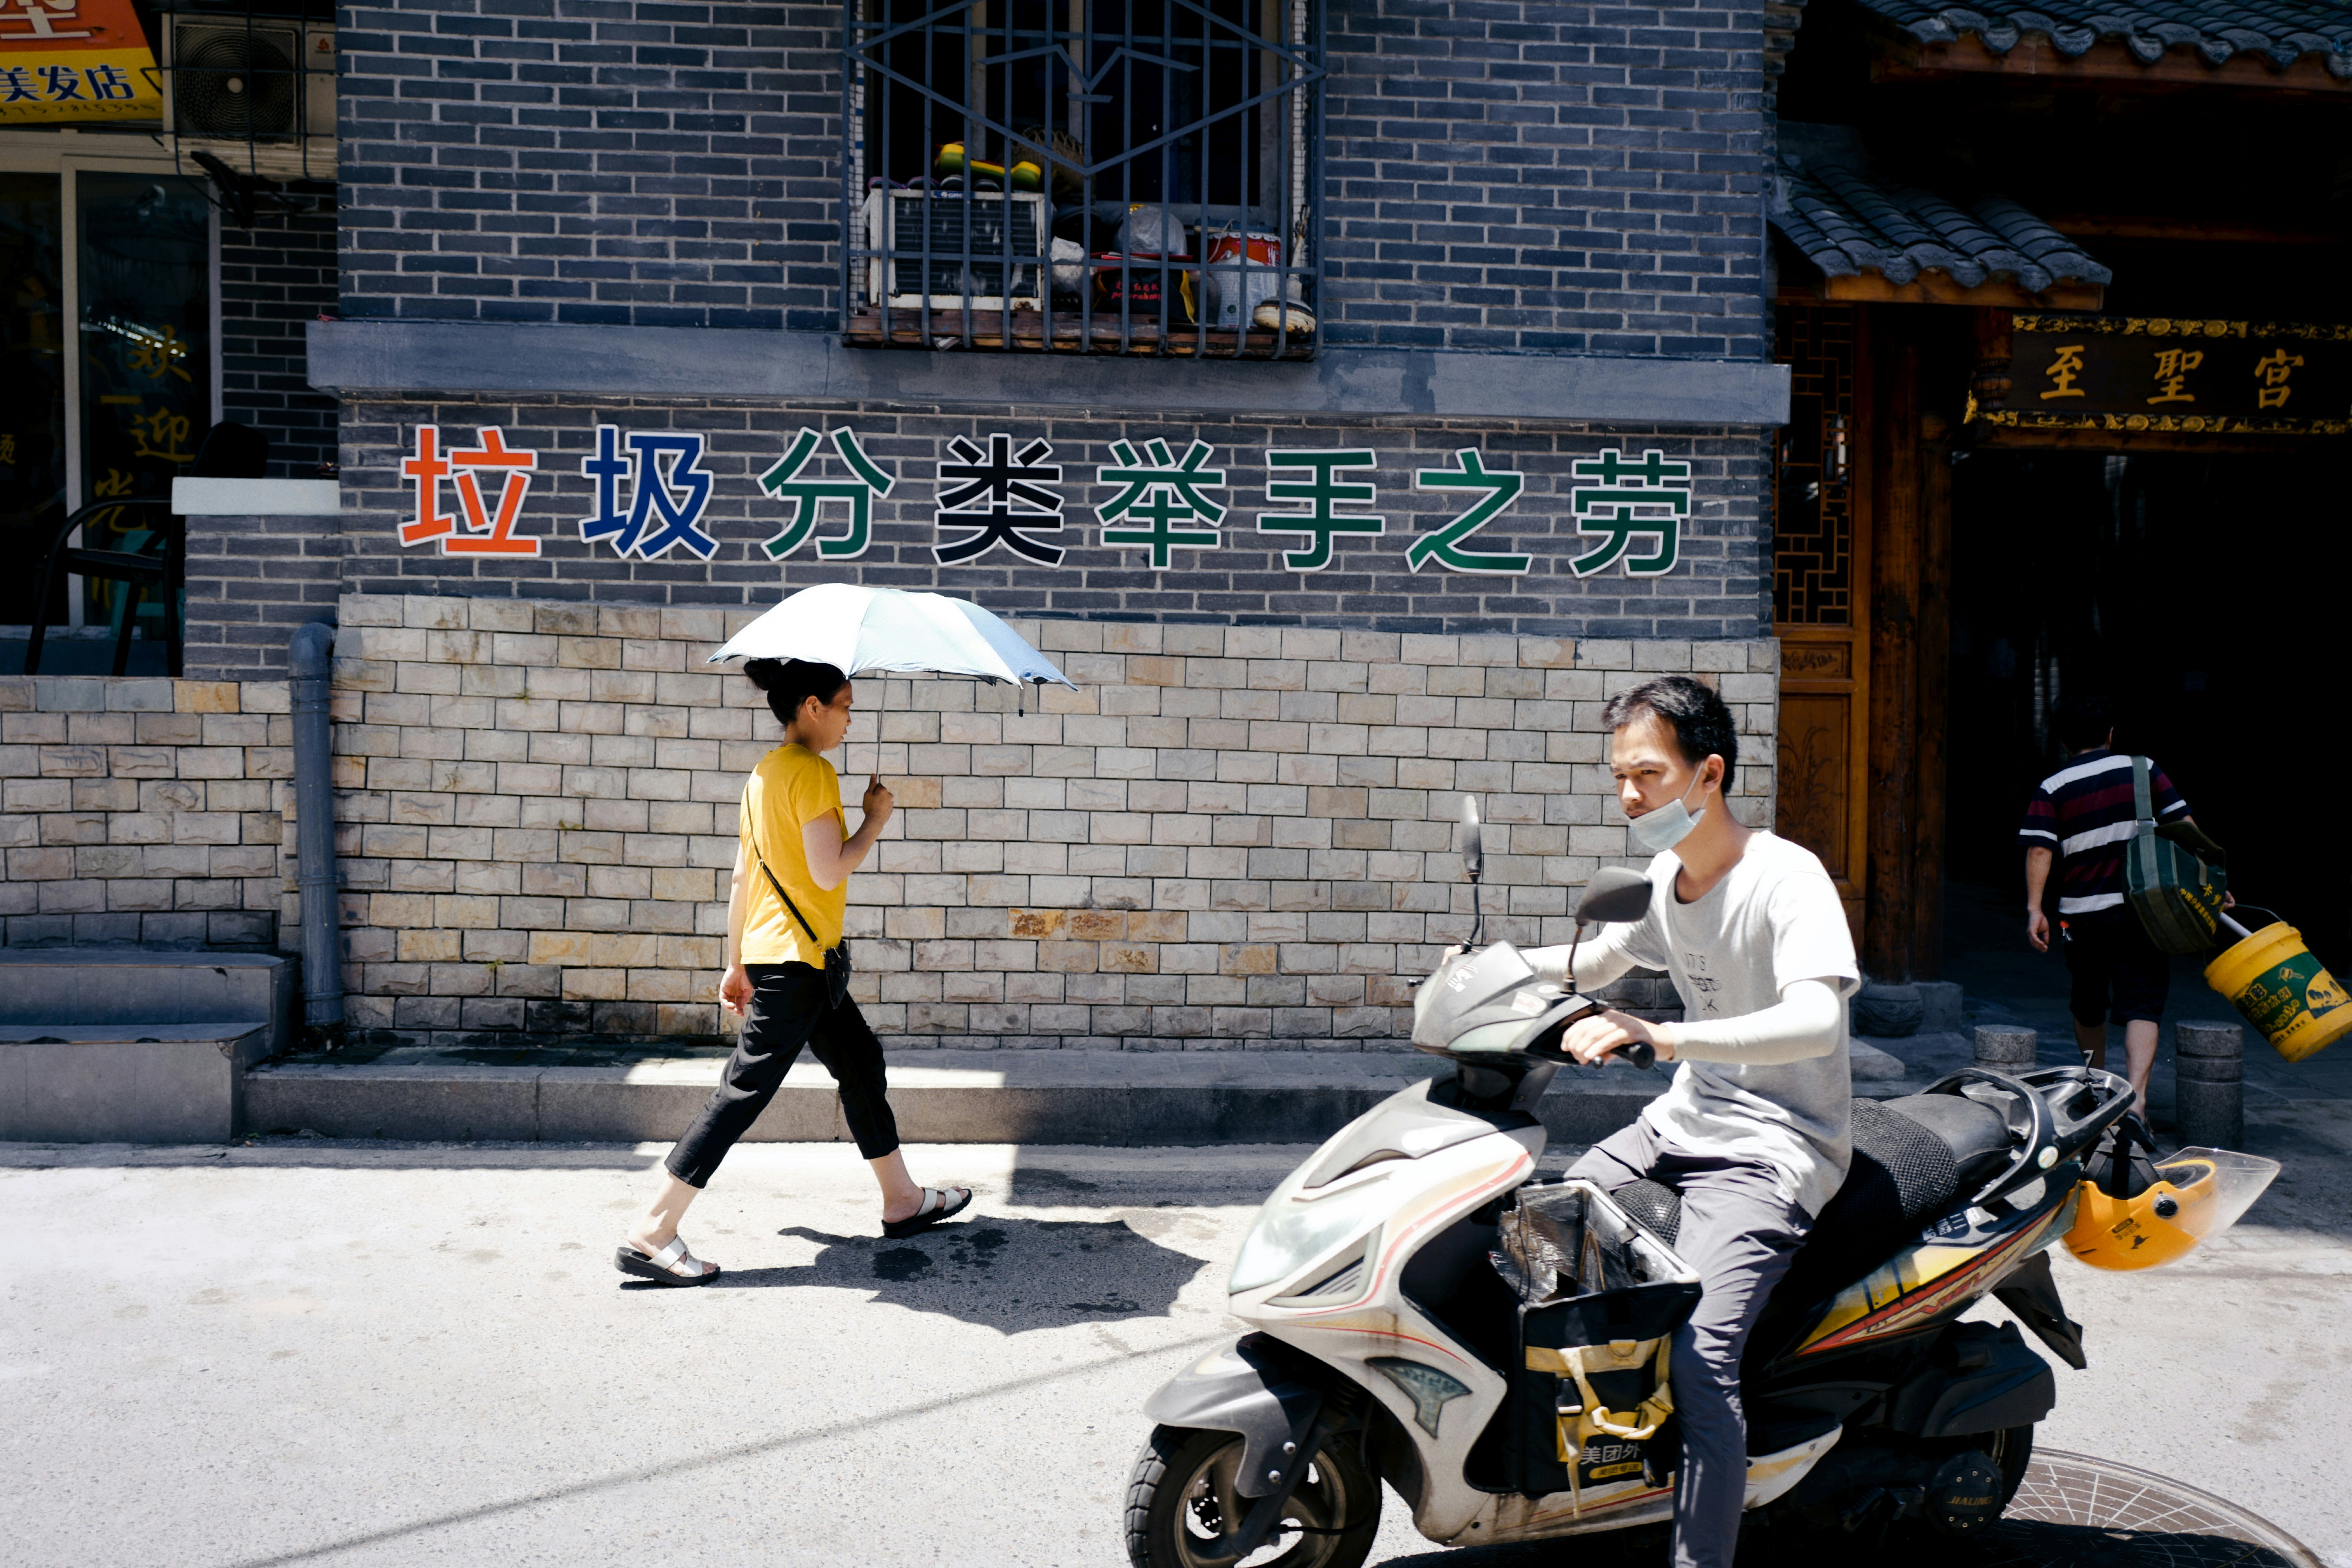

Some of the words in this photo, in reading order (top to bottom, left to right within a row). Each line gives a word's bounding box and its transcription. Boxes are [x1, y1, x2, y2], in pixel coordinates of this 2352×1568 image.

[0, 64, 135, 102] 美发店
[398, 424, 1691, 578] 垃圾分类举手之劳
[1580, 1443, 1641, 1466] 美团外
[1947, 1496, 1993, 1505] JIALING
